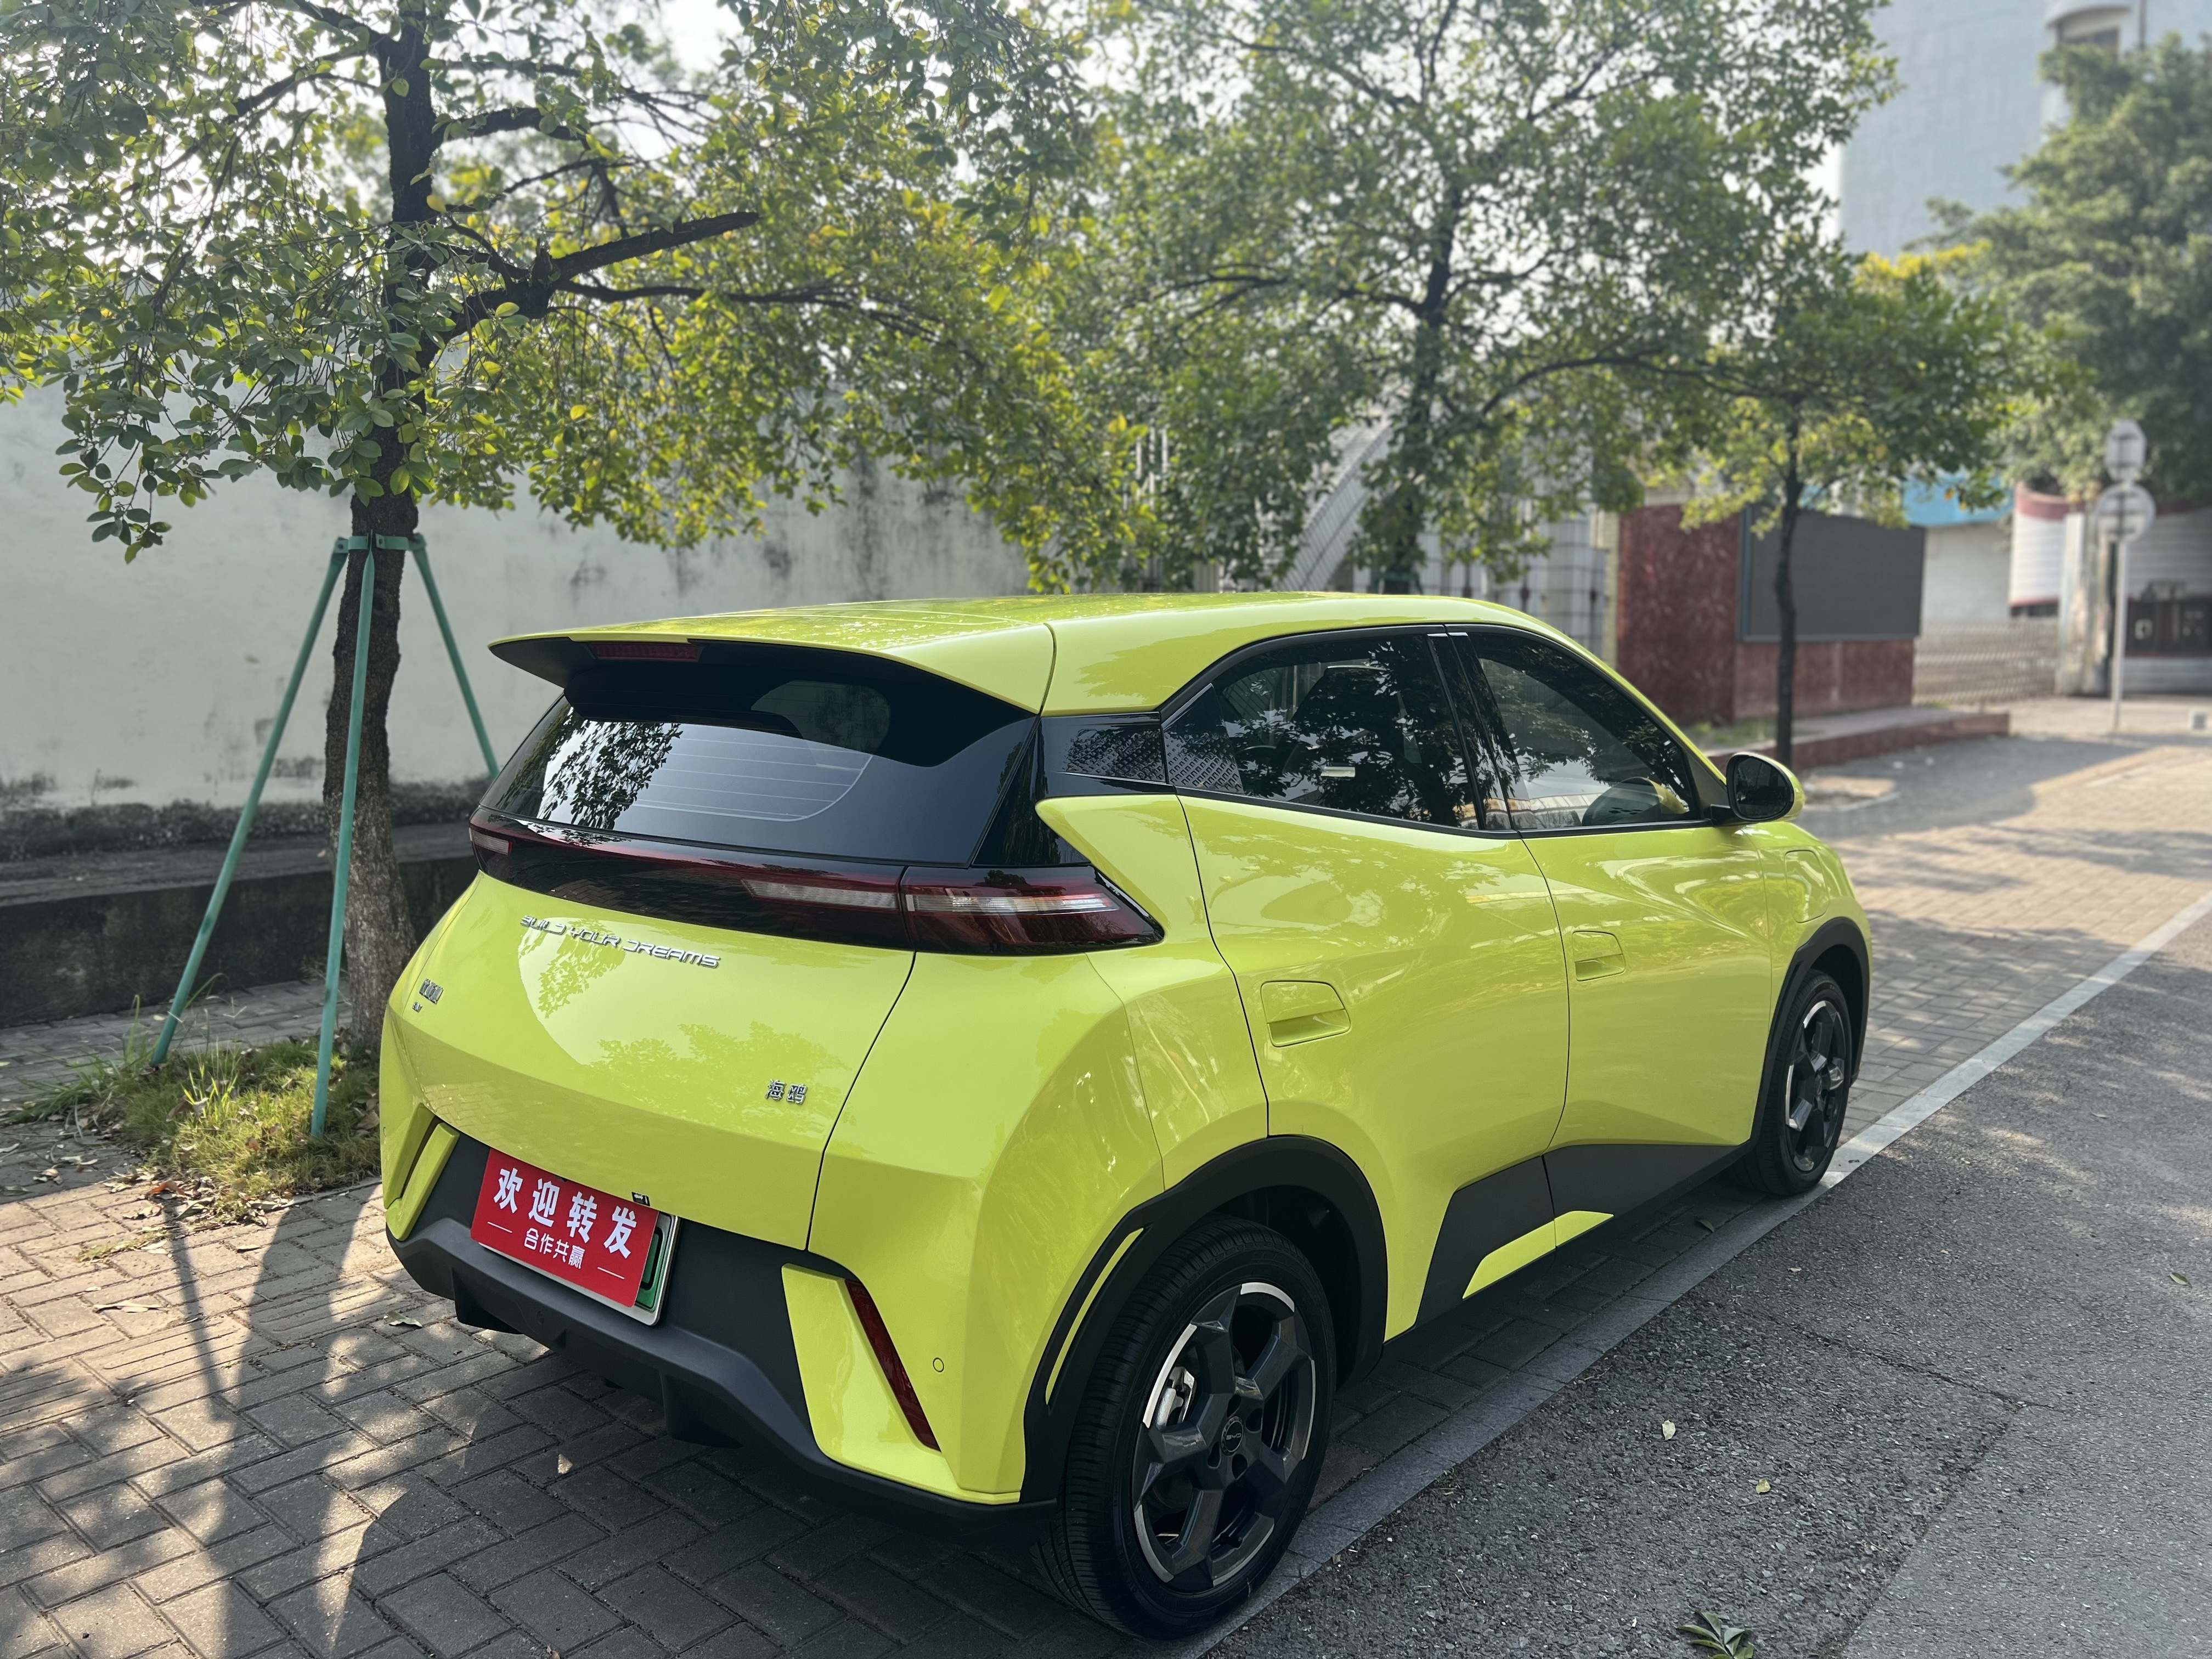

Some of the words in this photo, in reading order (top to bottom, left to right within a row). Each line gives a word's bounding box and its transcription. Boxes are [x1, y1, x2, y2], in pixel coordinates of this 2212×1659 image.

[520, 915, 567, 935] BUILD
[569, 926, 621, 948] YOUR
[623, 939, 721, 969] DREAMS
[765, 1079, 808, 1105] 海鸥
[494, 1167, 637, 1259] 欢迎转发
[523, 1227, 585, 1269] 合作共赢
